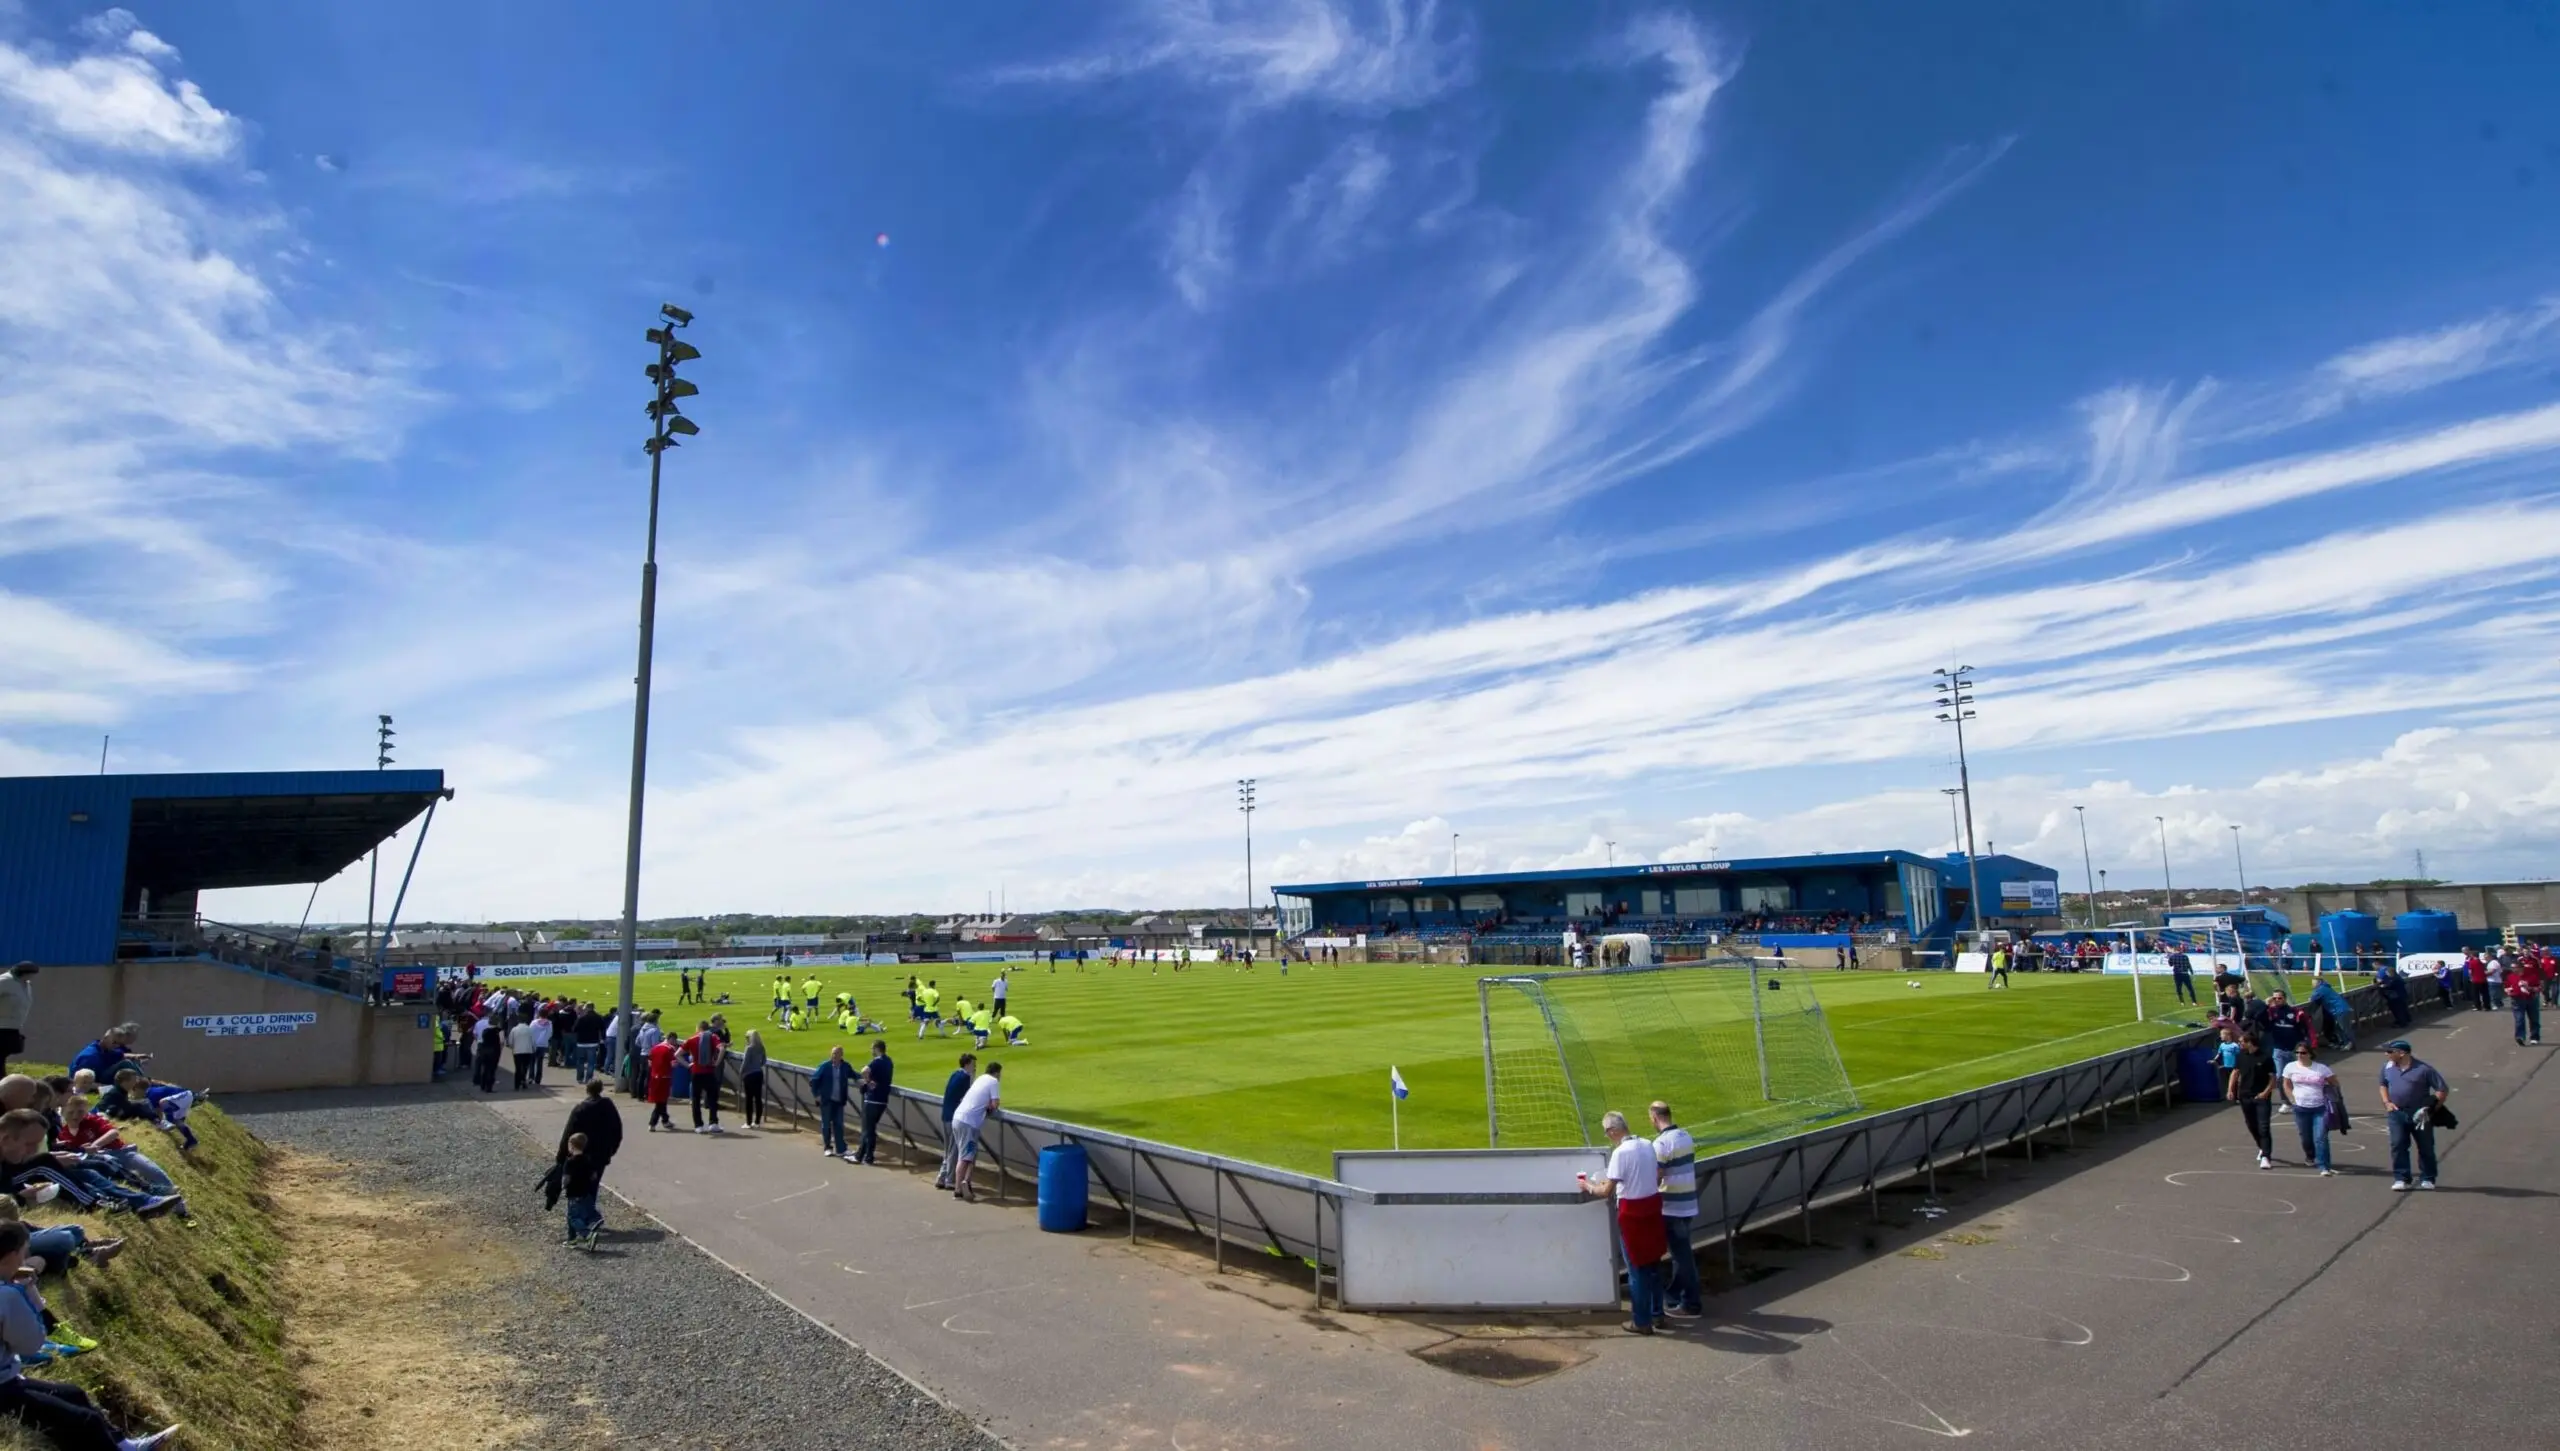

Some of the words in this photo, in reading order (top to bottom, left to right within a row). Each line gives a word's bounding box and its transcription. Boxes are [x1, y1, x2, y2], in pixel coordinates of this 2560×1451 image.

[1666, 864, 1698, 872] TAYLOR
[1700, 862, 1731, 871] GROUP
[494, 964, 568, 977] seatronics
[185, 1017, 212, 1026] HOT
[216, 1017, 225, 1026] &
[230, 1015, 265, 1025] COLD
[269, 1013, 314, 1024] DRINKS
[221, 1026, 239, 1035] PIE
[244, 1026, 250, 1034] &
[256, 1024, 293, 1034] BOVRIL
